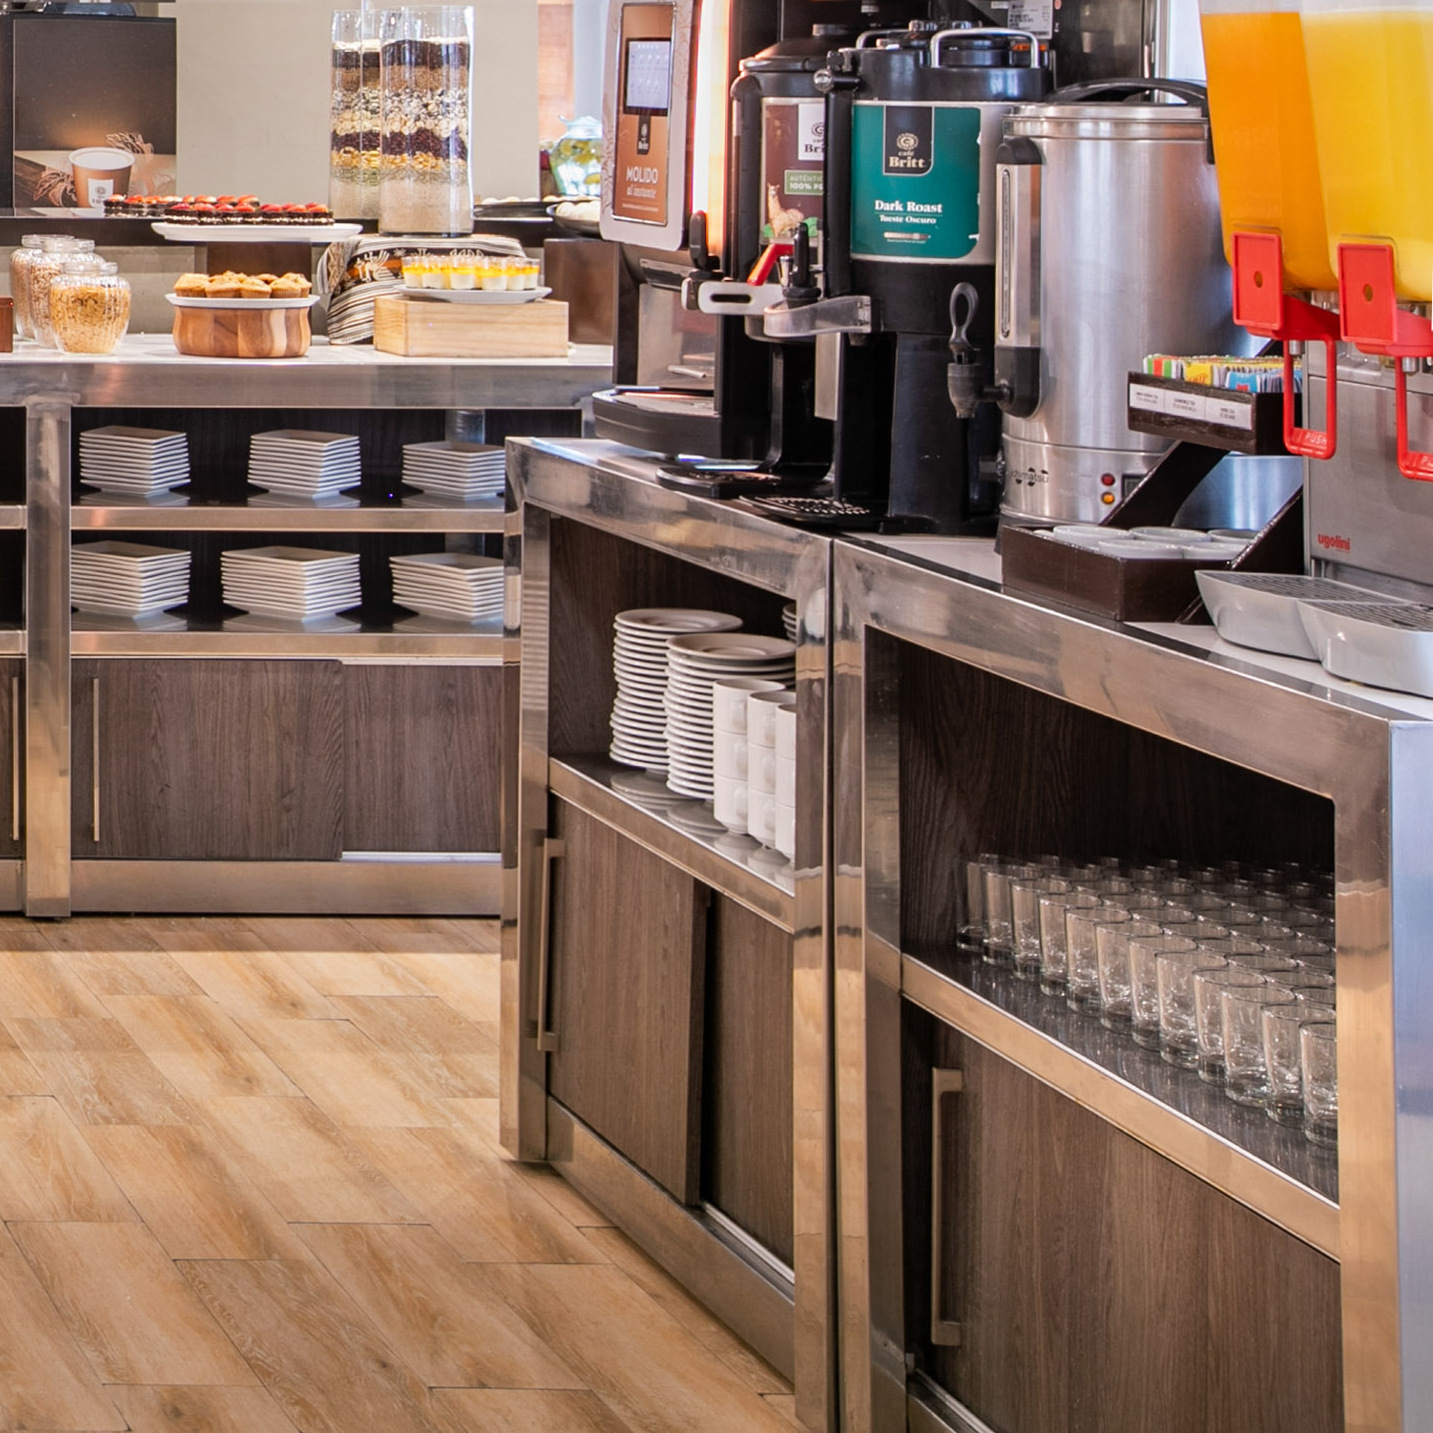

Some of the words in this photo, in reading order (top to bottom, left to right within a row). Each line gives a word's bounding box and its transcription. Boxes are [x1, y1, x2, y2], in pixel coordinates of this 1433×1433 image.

[889, 156, 925, 168] Britt
[626, 166, 659, 185] MOLIDO
[789, 182, 812, 190] 100%
[874, 199, 904, 212] Dark
[906, 201, 943, 213] Roast
[879, 214, 903, 223] Tueste
[905, 215, 937, 224] Oscuro
[1305, 431, 1327, 445] PUSH
[1317, 534, 1350, 550] ugolini
